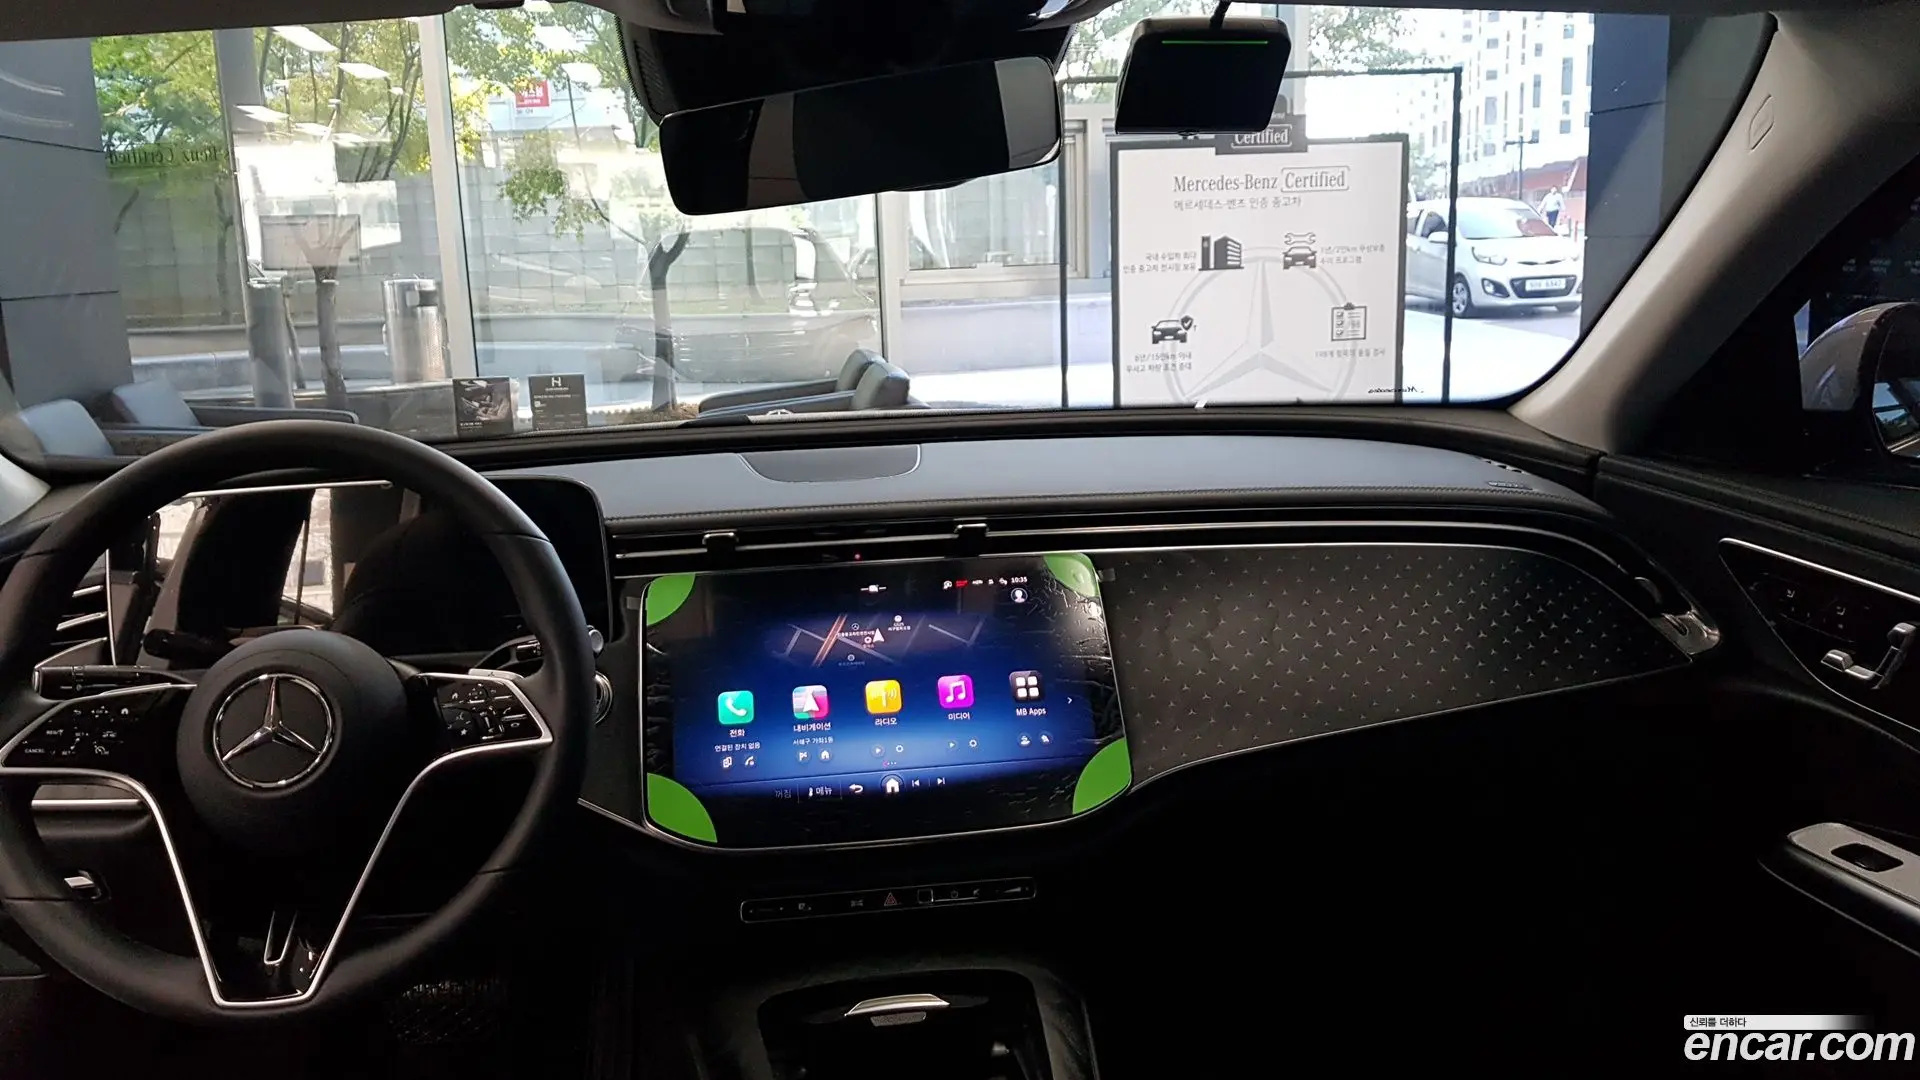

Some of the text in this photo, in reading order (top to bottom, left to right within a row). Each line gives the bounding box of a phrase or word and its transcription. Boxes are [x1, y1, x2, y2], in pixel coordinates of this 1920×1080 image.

[1234, 128, 1289, 145] Certified
[1173, 171, 1345, 192] Mercedes-Benz Certified
[1173, 195, 1302, 211] 메르세데스-벤츠 인증 중고차
[1011, 576, 1028, 584] 10:35
[947, 713, 971, 721] 미디어
[1016, 707, 1047, 717] MB Apps
[874, 717, 897, 726] 라디오
[793, 722, 832, 733] 내비게이션
[728, 729, 746, 738] 전화
[815, 786, 833, 796] 메뉴
